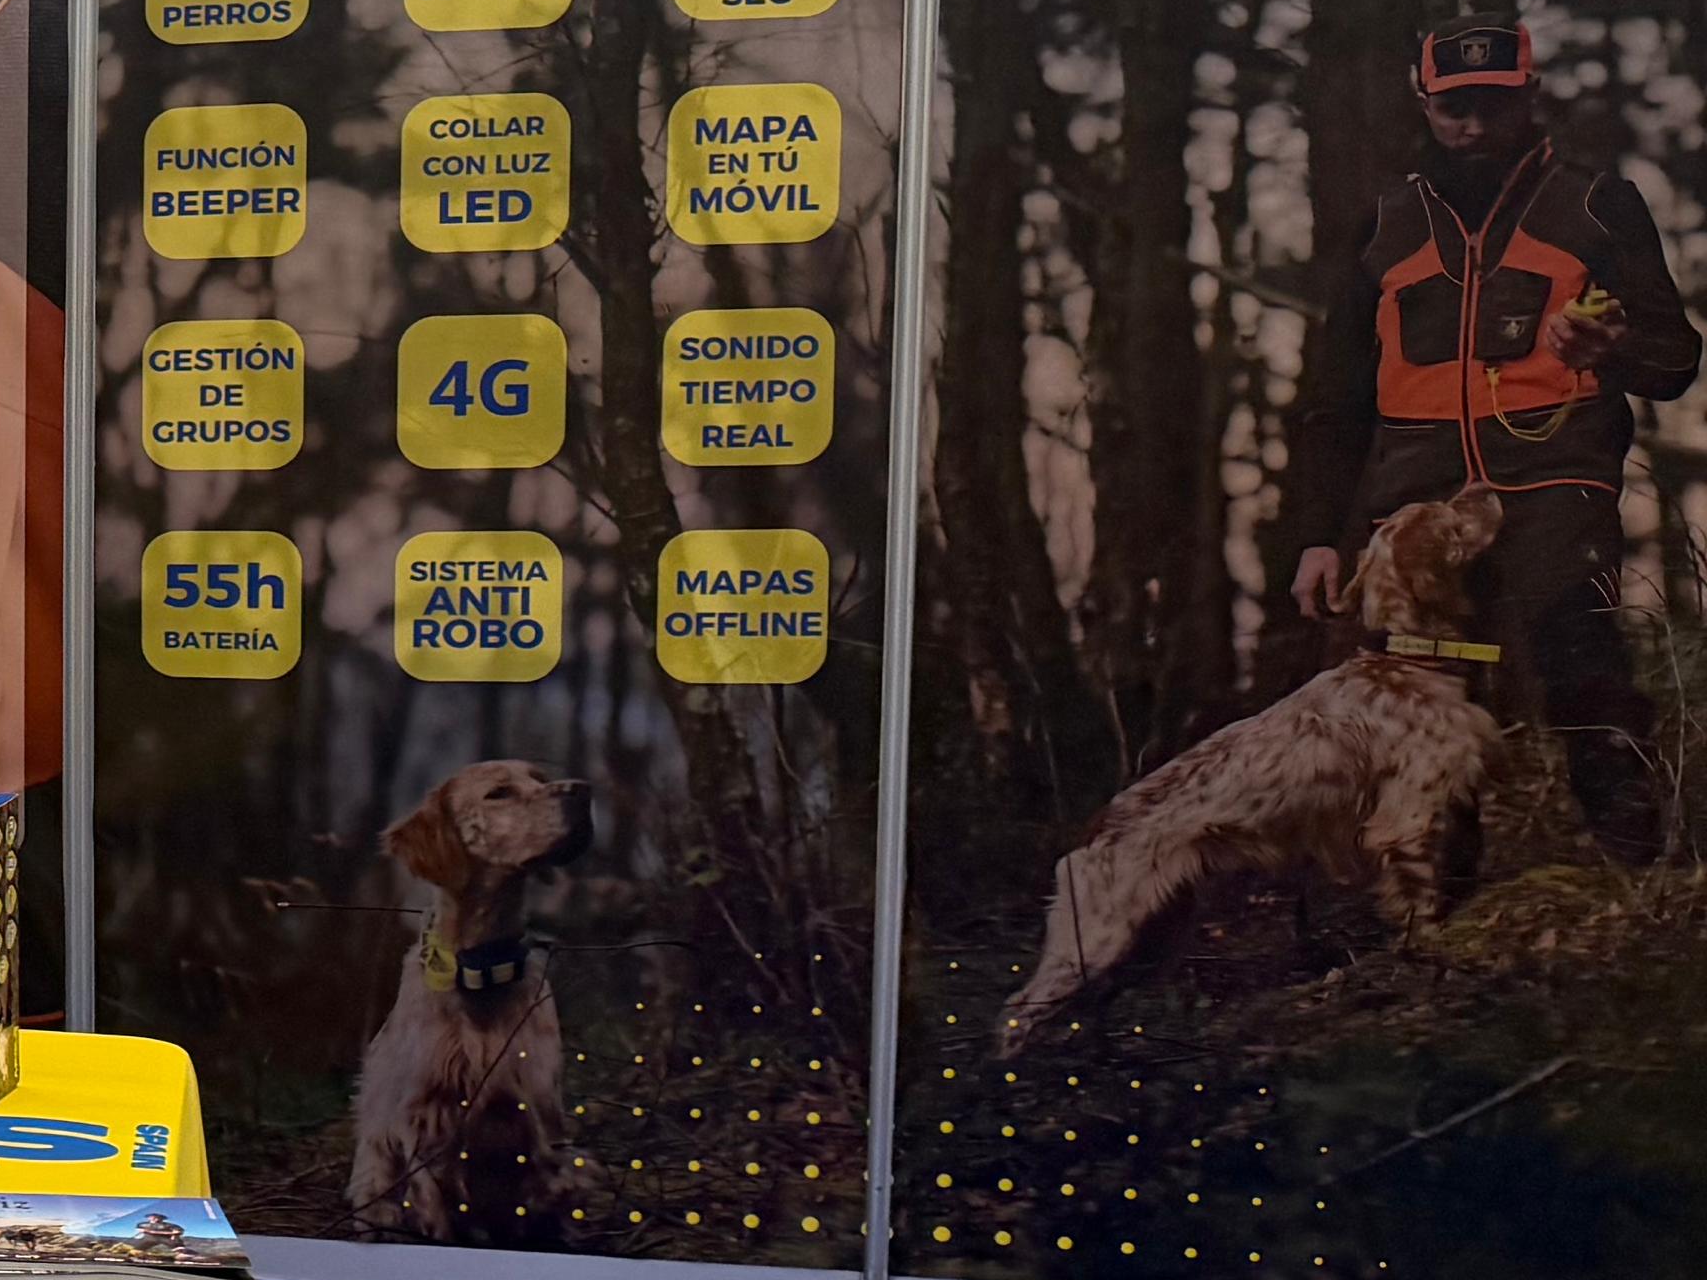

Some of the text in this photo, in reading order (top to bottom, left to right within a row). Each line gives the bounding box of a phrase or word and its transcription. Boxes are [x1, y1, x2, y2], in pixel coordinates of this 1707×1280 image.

[162, 0, 292, 29] PERROS
[429, 115, 546, 140] COLLAR
[693, 114, 819, 145] MAPA
[156, 140, 296, 172] FUNCIÓN
[421, 151, 551, 178] CON LUZ
[708, 146, 799, 175] EN TÚ
[151, 186, 301, 218] BEEPER
[438, 188, 533, 225] LED
[689, 178, 820, 215] MÓVIL
[147, 342, 295, 373] GESTIÓN
[678, 334, 820, 361] SONIDO
[199, 383, 244, 408] DE
[428, 358, 531, 418] 4G
[678, 378, 817, 406] TIEMPO
[151, 418, 292, 444] GRUPOS
[701, 423, 794, 449] REAL
[162, 561, 285, 610] 55h
[409, 560, 549, 583] SISTEMA
[675, 568, 815, 596] MAPAS
[422, 585, 531, 617] ANTI
[163, 626, 280, 652] BATERÍA
[412, 618, 545, 650] ROBO
[664, 611, 823, 638] OFFLINE
[132, 1124, 169, 1171] SPAIN
